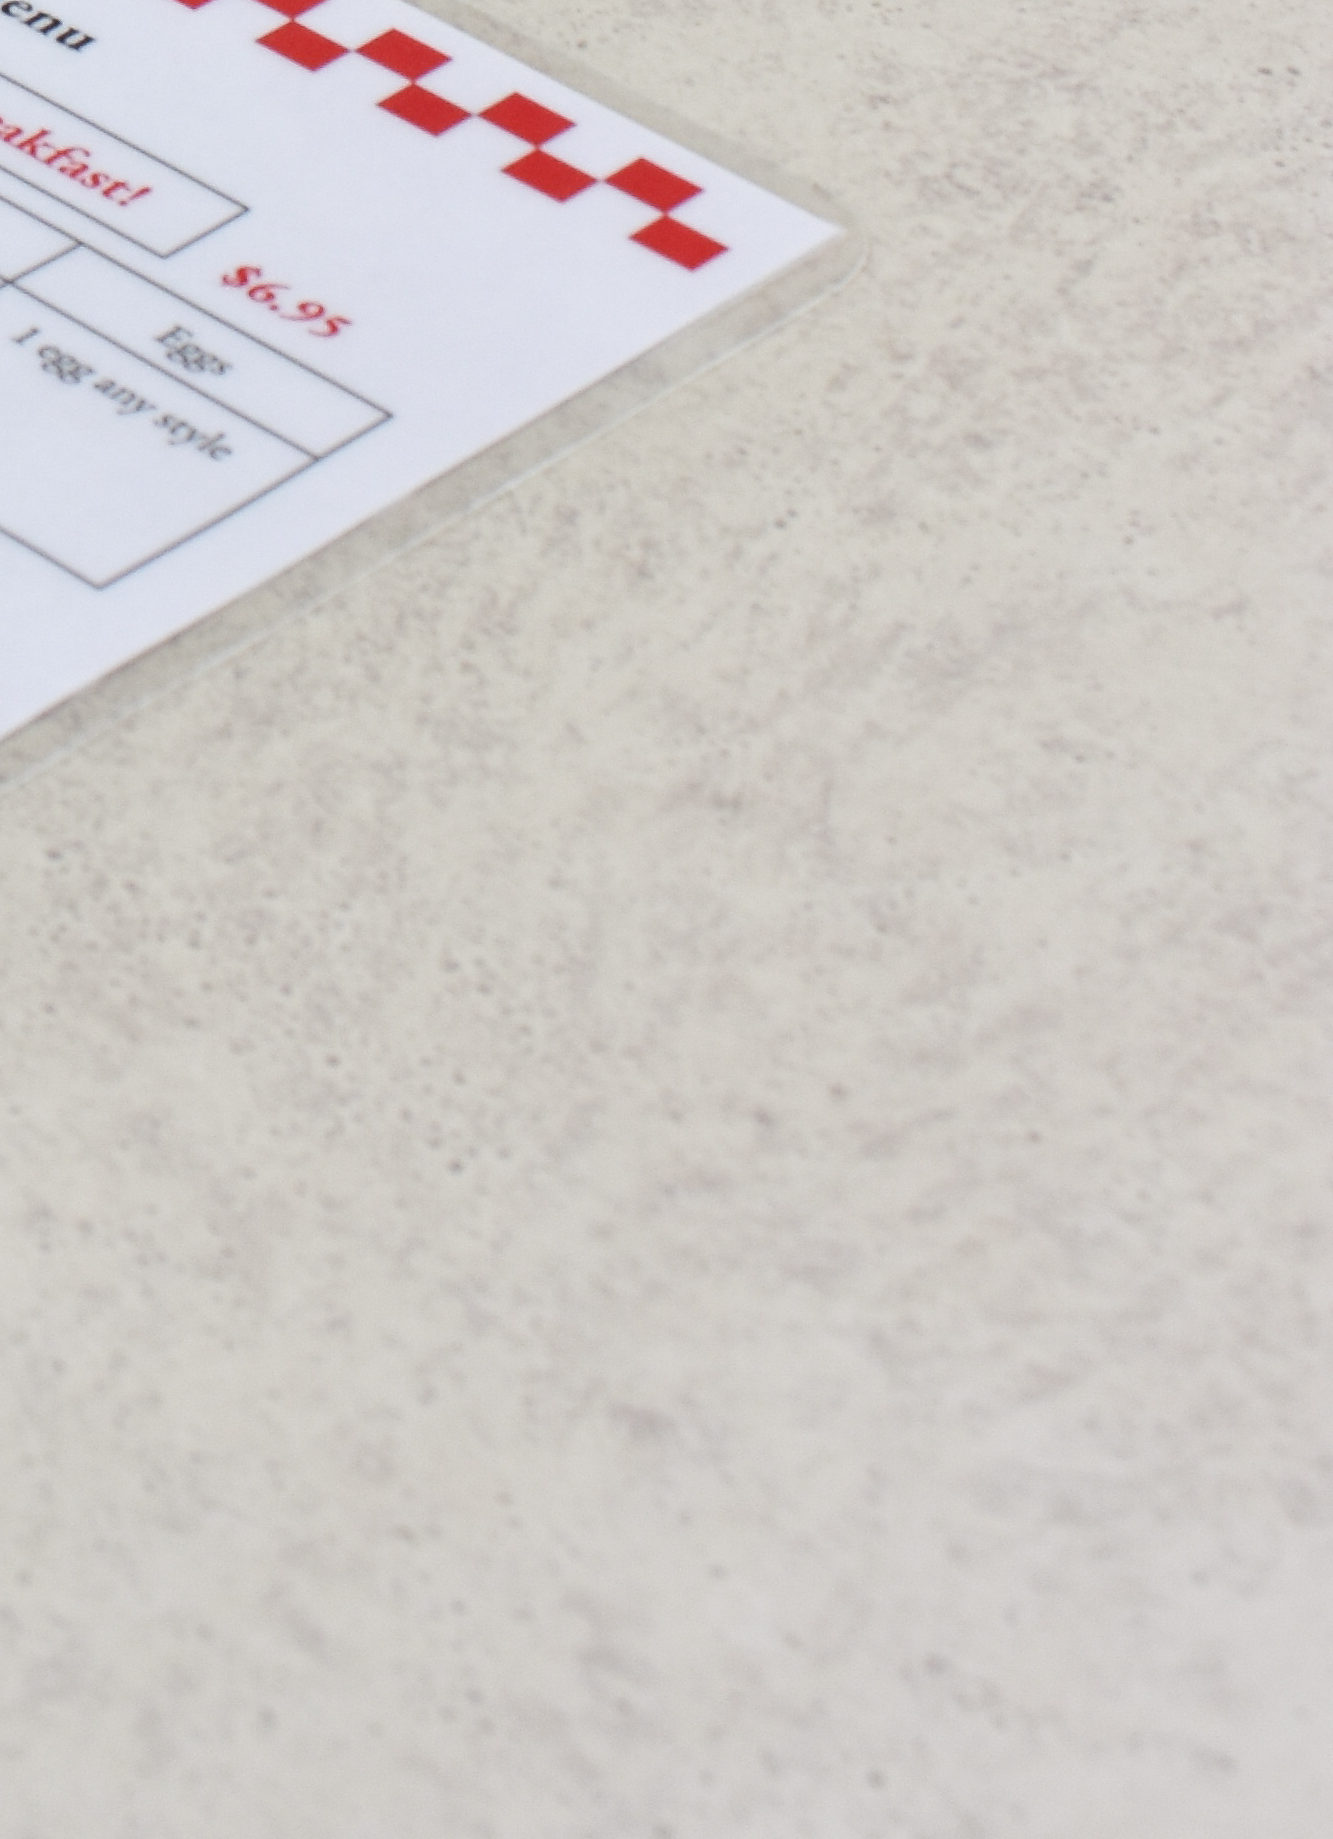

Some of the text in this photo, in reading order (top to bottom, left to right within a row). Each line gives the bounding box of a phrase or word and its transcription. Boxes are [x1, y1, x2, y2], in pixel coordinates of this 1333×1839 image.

[220, 265, 353, 338] $6.95
[153, 324, 233, 376] Eggs
[11, 326, 233, 462] 1 egg any style
